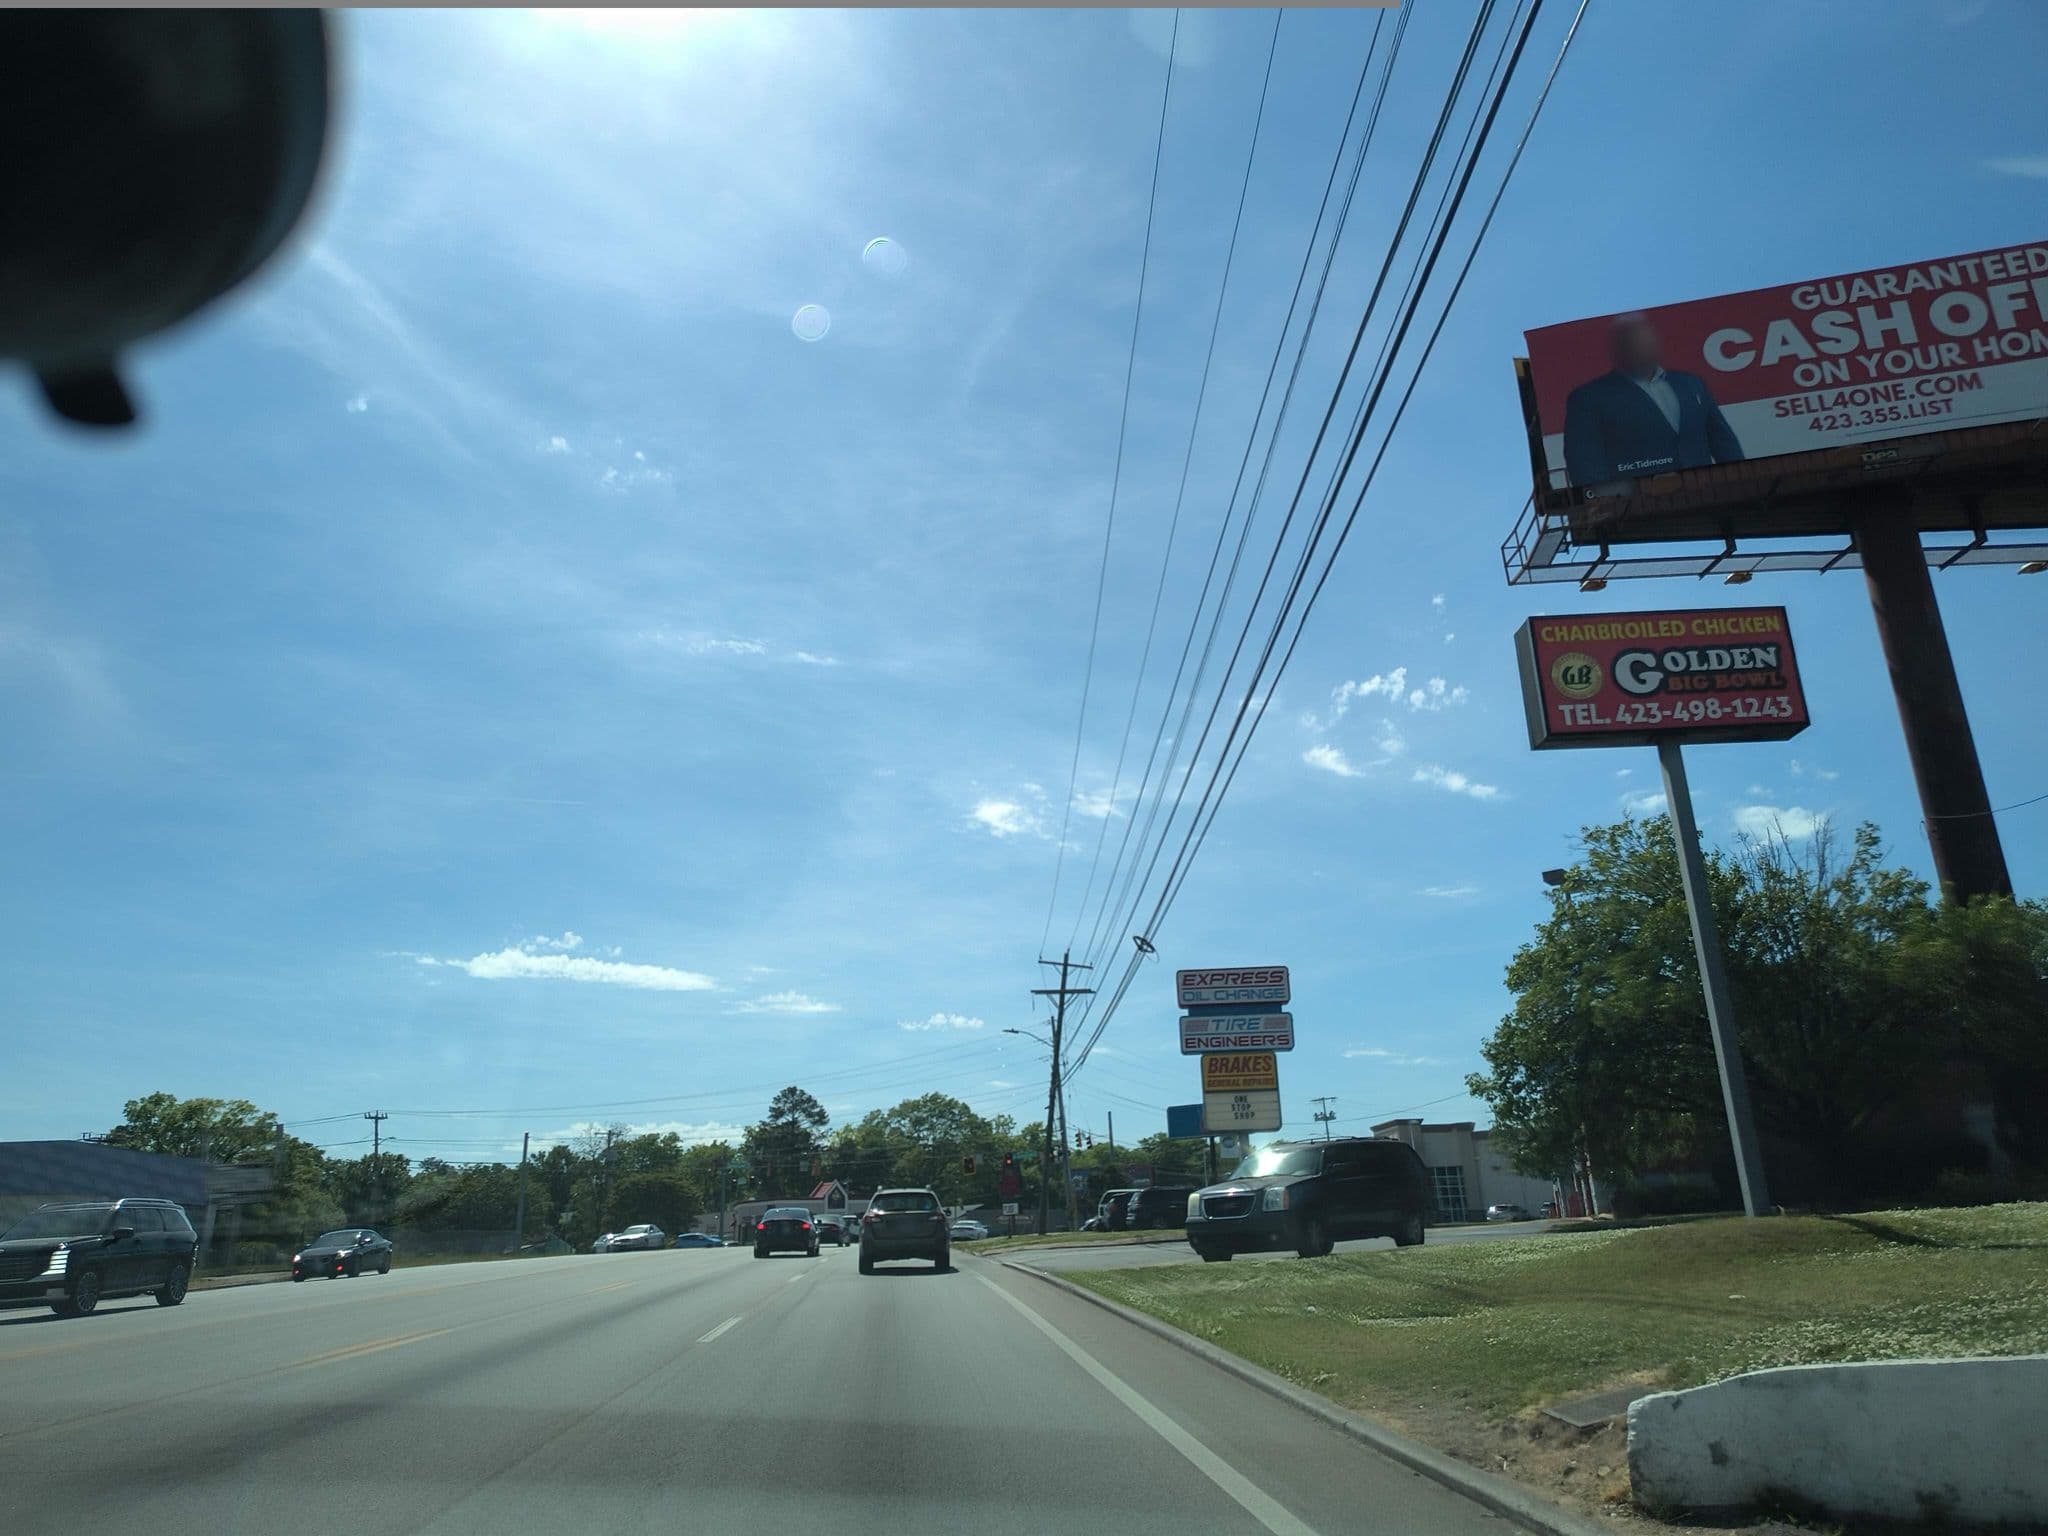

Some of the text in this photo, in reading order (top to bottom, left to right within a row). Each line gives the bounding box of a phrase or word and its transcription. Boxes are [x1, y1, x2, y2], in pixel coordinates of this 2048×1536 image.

[1791, 248, 2048, 310] GUARANTEED
[1703, 299, 1919, 373] CASH
[1793, 358, 1850, 388] ON
[1856, 342, 1968, 378] YOUR
[1774, 371, 1983, 418] SELL4ONE.COM
[1808, 398, 1953, 432] 423.355.LIST
[1541, 615, 1781, 643] CHARBROILED CHICKEN
[1614, 646, 1778, 695] GOLDEN
[1668, 671, 1783, 691] BIG BOWL
[1558, 696, 1793, 726] TEL. 423-498-1243
[1182, 970, 1284, 987] EXPRESS
[1183, 987, 1286, 1002] OIL CHANGE
[1212, 1017, 1261, 1031] TIRE
[1184, 1034, 1290, 1049] ENGINEERS
[1208, 1055, 1273, 1073] BRAKES
